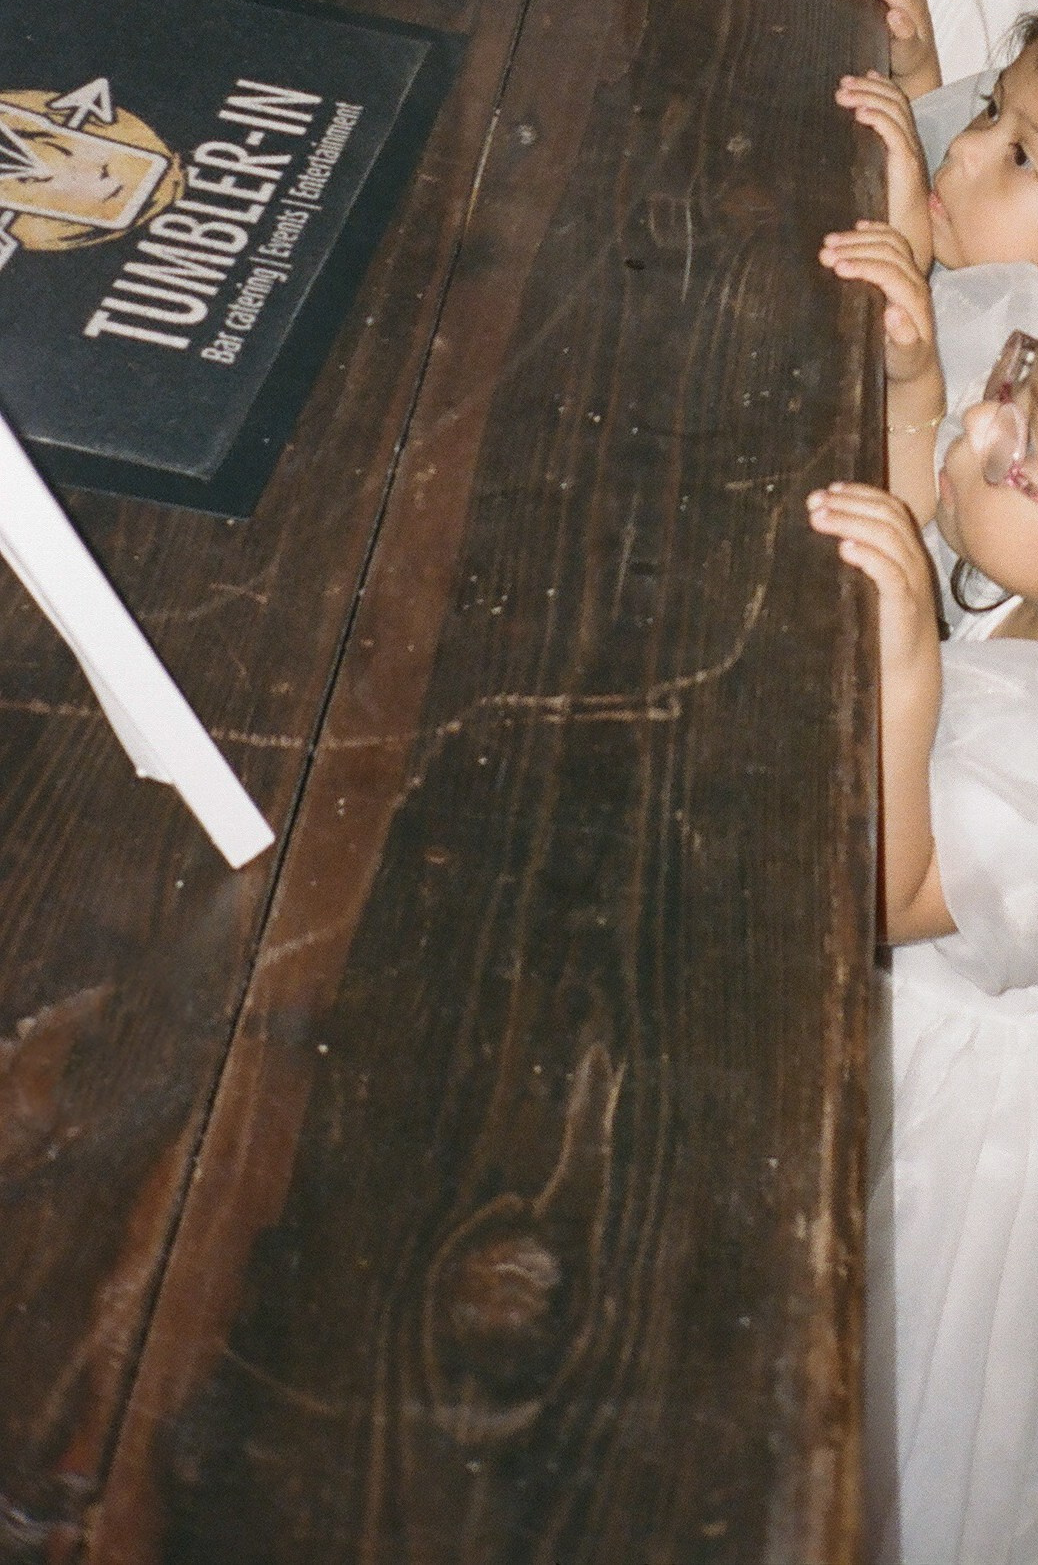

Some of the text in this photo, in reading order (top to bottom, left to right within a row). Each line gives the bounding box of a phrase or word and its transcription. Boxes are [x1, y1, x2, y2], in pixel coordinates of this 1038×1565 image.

[84, 79, 323, 349] TUMBLER-IN
[201, 332, 245, 365] Bar
[225, 267, 288, 331] catering
[258, 210, 309, 258] Events
[288, 102, 364, 201] Entertainment
